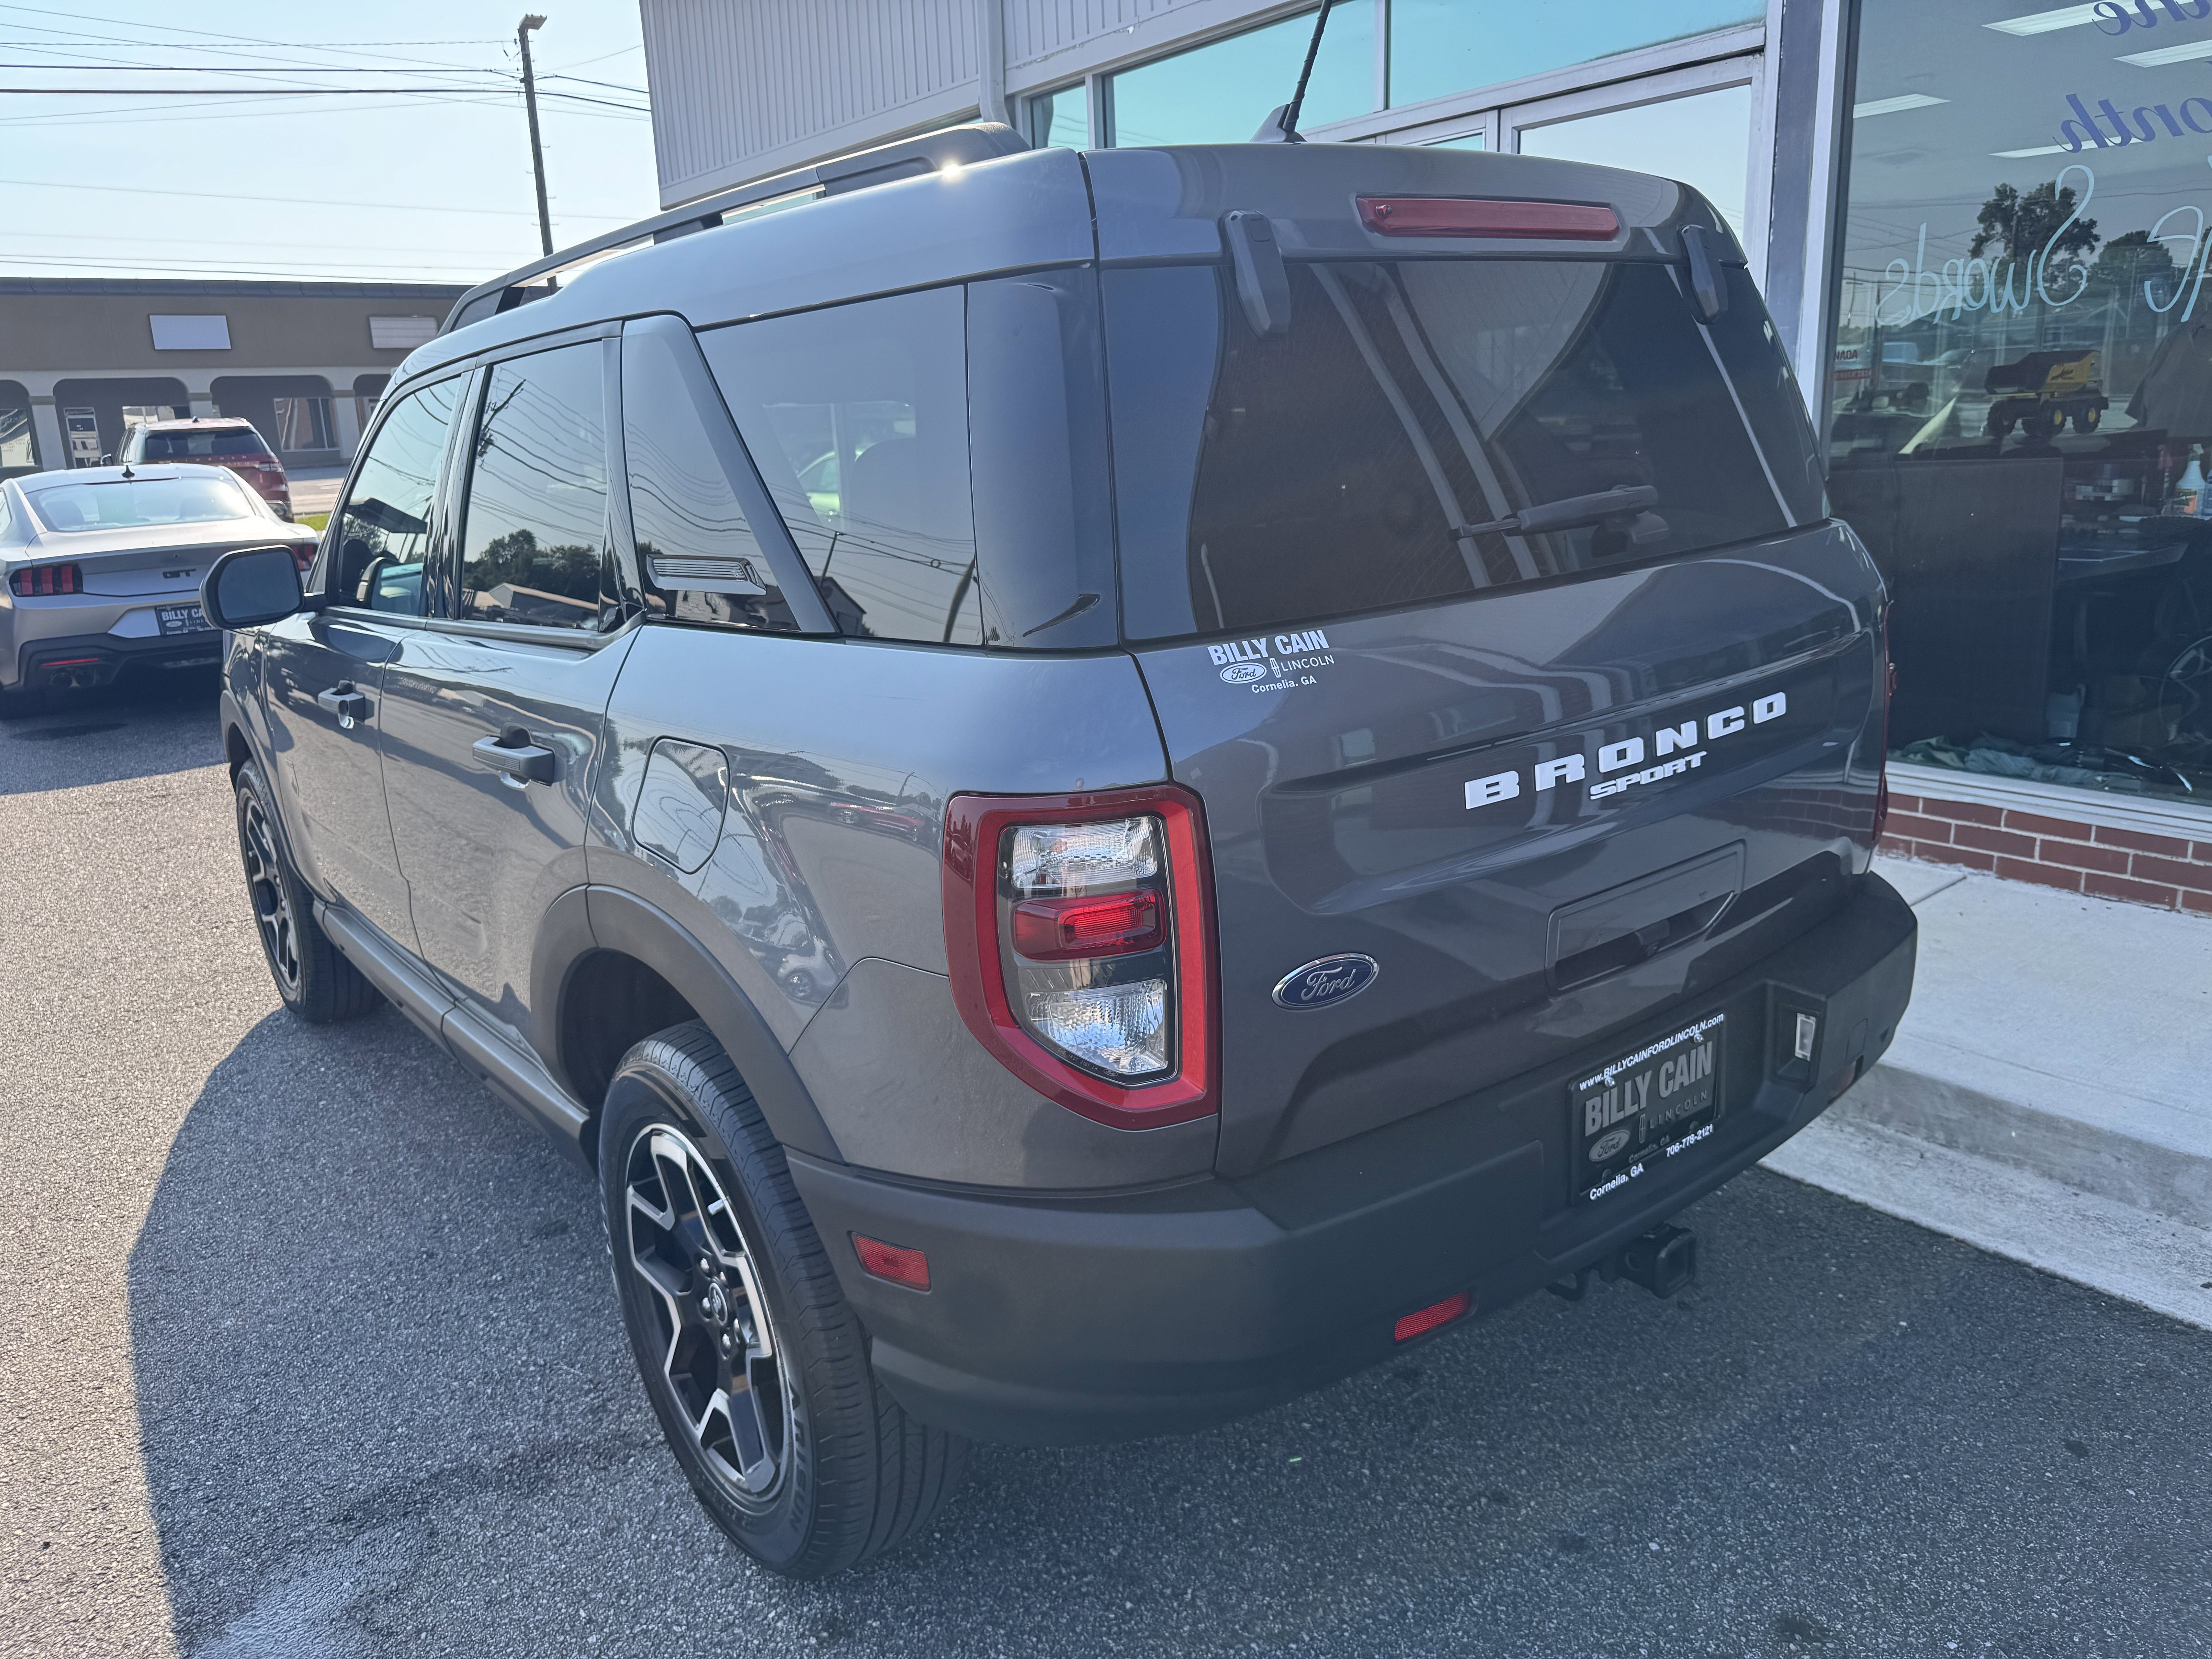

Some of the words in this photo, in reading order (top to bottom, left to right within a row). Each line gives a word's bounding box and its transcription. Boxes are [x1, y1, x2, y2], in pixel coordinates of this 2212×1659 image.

[163, 568, 196, 579] GT
[161, 609, 188, 621] BILLY
[191, 608, 204, 618] CA
[1207, 638, 1269, 665] BILLY
[1274, 630, 1329, 654] CAIN
[1281, 655, 1335, 672] LINCOLN
[1231, 667, 1257, 680] Ford
[1300, 675, 1317, 685] GA
[1465, 692, 1786, 809] BRONCO
[1590, 751, 1707, 800] SPORT
[1301, 966, 1357, 1001] Ford
[1579, 1013, 1724, 1091] www.BILLYCAINFORDLINCOLN.com
[1585, 1070, 1652, 1137] BILLY
[1659, 1041, 1712, 1098] CAIN
[1650, 1089, 1707, 1129] LINCOLN
[1598, 1137, 1621, 1158] Ford
[1666, 1124, 1714, 1158] 706-778-2121
[1590, 1174, 1629, 1200] Cornelia,
[1630, 1163, 1644, 1178] GA
[787, 1377, 806, 1533] ARISUN
